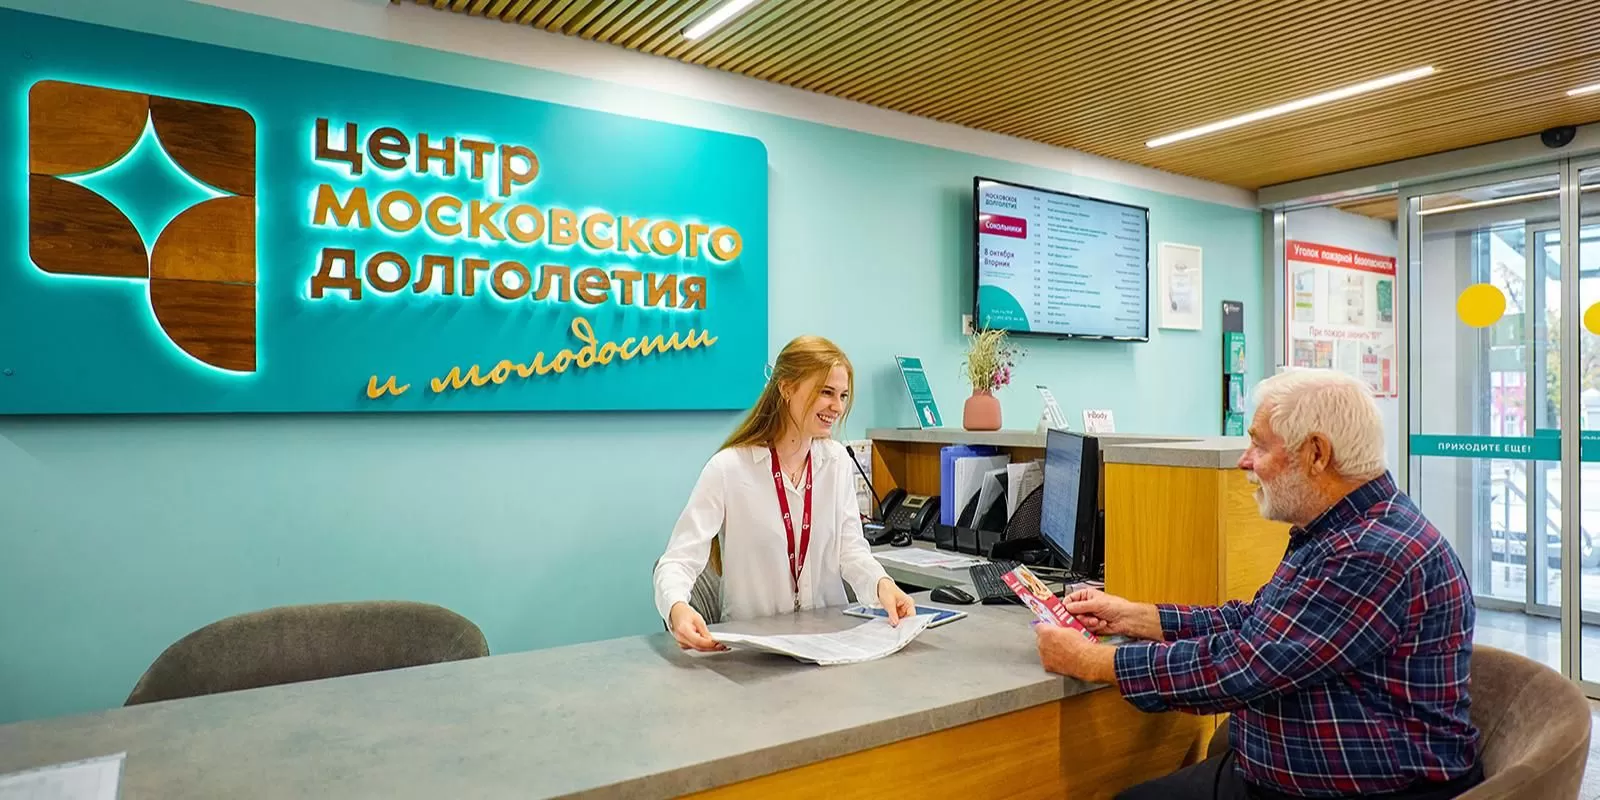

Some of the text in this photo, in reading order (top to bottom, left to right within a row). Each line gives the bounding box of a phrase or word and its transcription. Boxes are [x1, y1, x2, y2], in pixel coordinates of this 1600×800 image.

[315, 117, 540, 197] центр
[985, 221, 1023, 233] Сокольники
[984, 248, 1015, 259] 8 октября
[1294, 243, 1319, 257] Уголок
[1321, 250, 1353, 264] пожарной
[984, 258, 1011, 267] Вторник
[367, 316, 719, 400] и молодости
[1438, 442, 1531, 453] ПРИХОДИТЕ ЕЩЕ!
